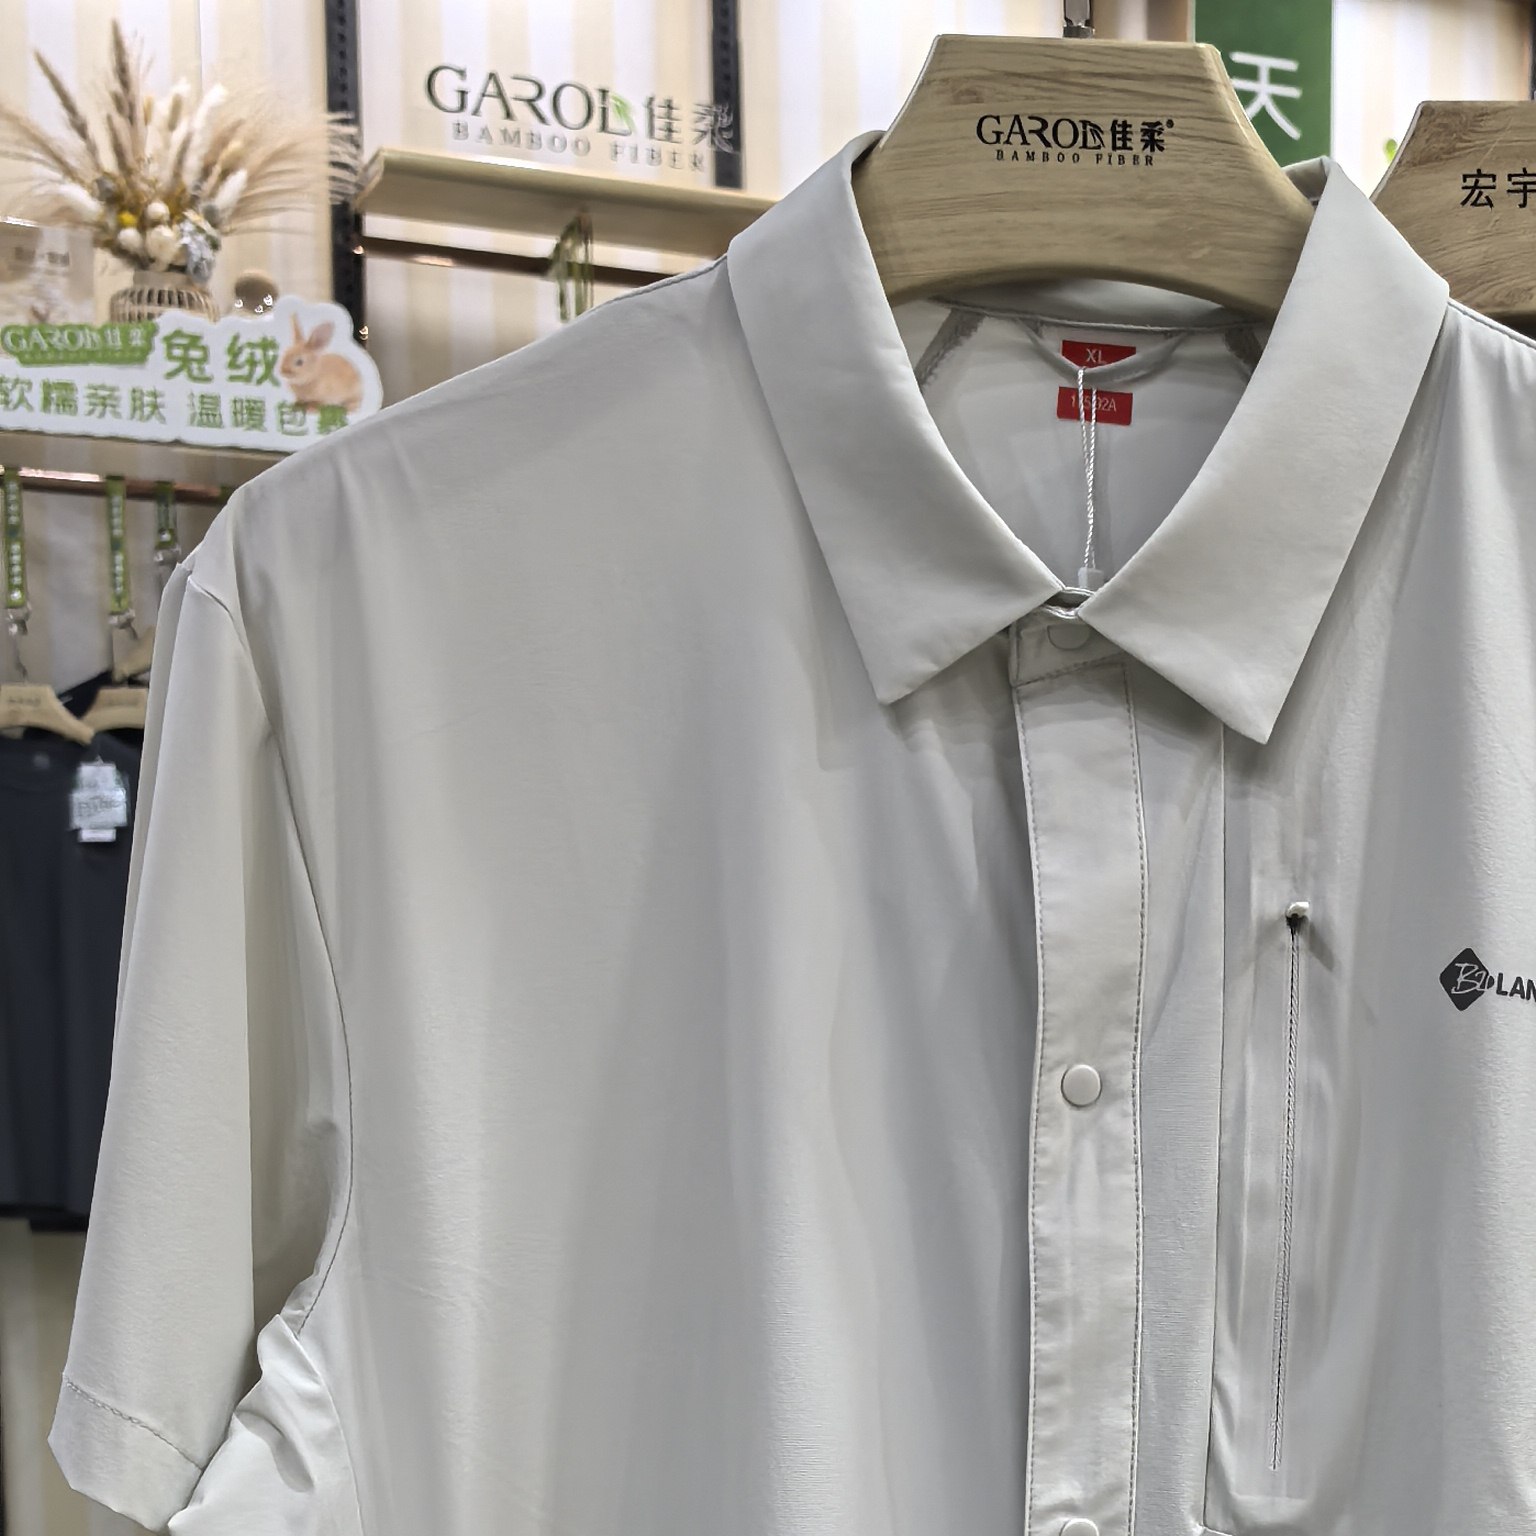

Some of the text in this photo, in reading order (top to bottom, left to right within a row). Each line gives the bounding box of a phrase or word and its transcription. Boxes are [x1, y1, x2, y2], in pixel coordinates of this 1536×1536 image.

[1229, 51, 1303, 141] 天
[451, 119, 707, 173] BAMBOO FIBER
[996, 149, 1154, 166] BAMBOO FIBER
[160, 327, 281, 388] 兔绒
[1086, 348, 1108, 364] XL
